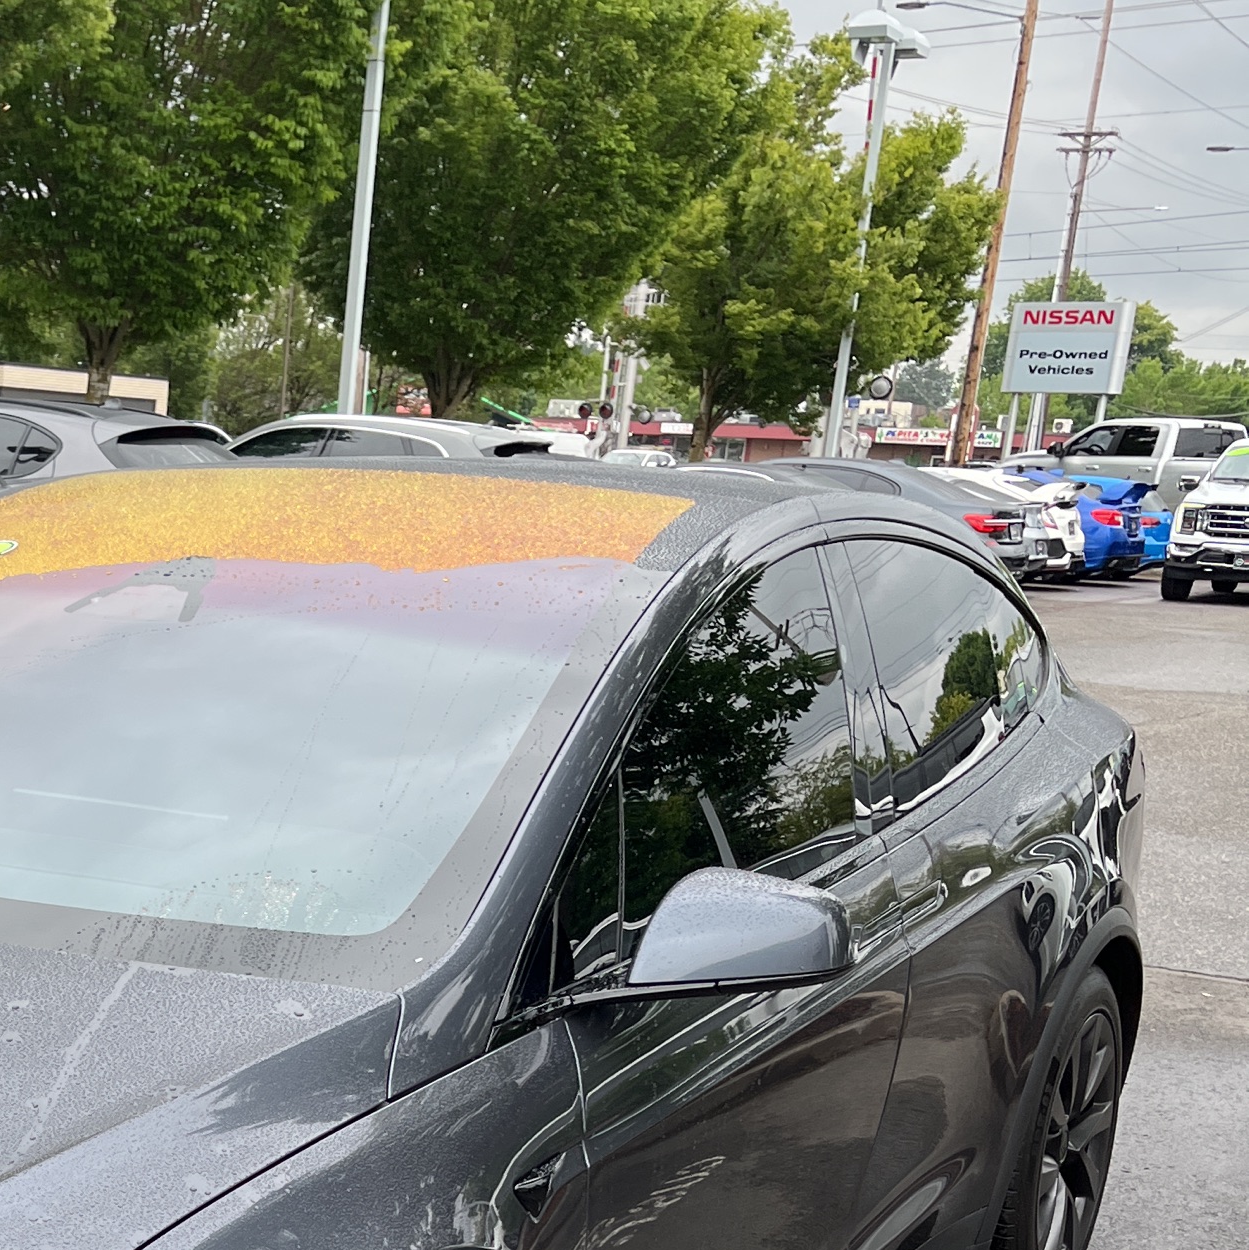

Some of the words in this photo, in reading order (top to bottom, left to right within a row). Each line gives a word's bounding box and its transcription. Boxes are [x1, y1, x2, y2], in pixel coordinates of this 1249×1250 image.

[1023, 310, 1115, 325] NISSAN
[1019, 349, 1109, 360] Pre-Owned
[1028, 365, 1094, 375] Vehicles
